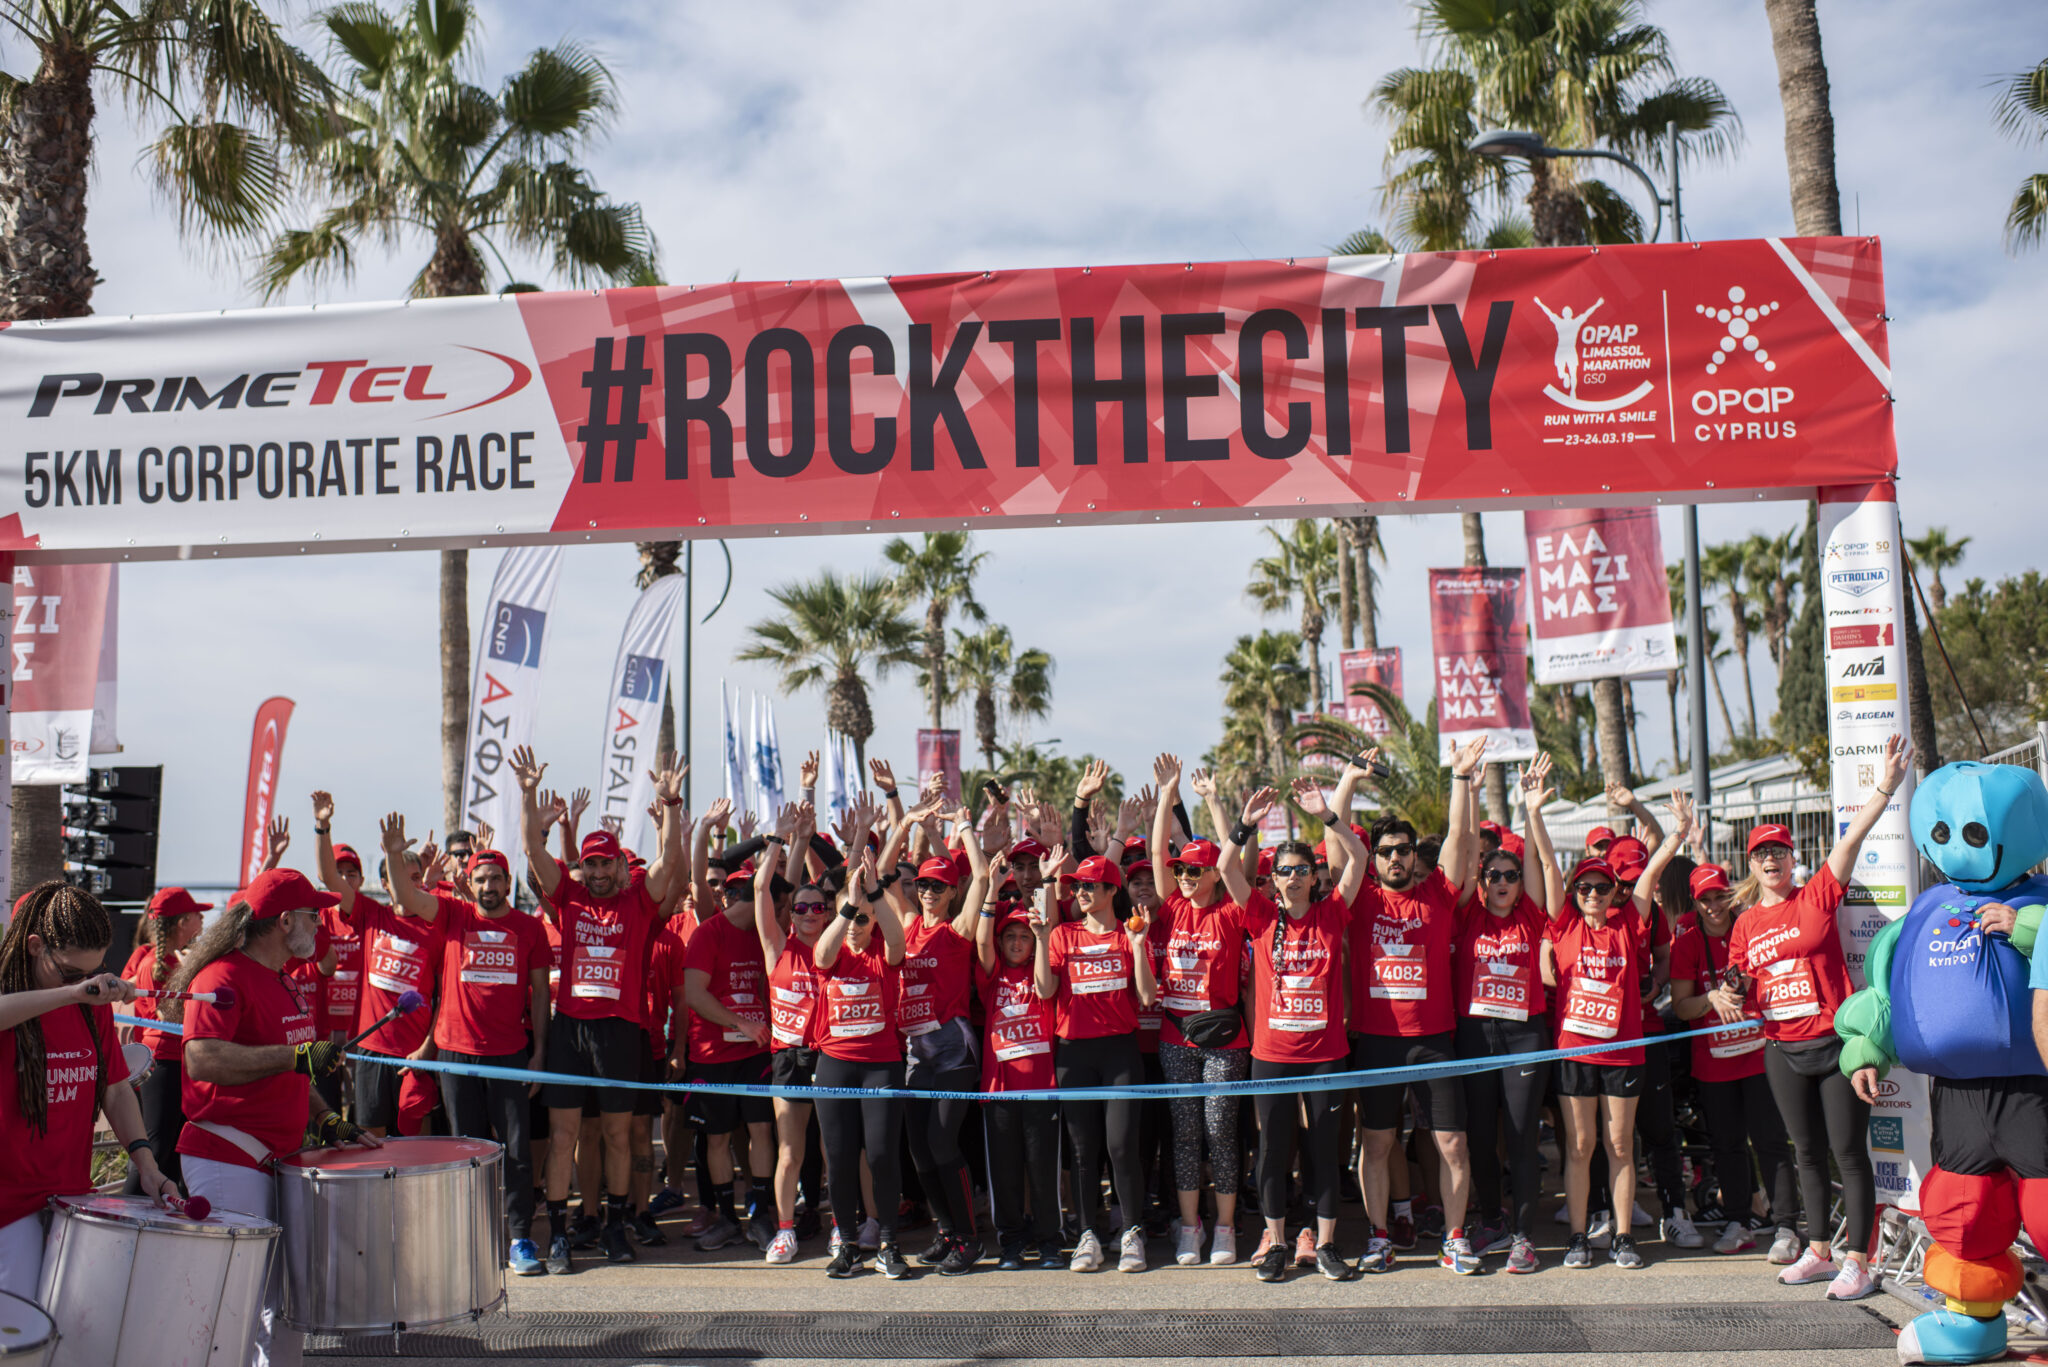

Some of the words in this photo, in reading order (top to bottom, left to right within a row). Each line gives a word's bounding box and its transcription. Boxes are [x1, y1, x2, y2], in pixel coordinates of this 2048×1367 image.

[1581, 324, 1639, 345] OPAP
[1582, 345, 1644, 359] LIMASSOL
[1583, 358, 1651, 372] MARATHON
[1583, 373, 1607, 385] GSO
[577, 300, 1515, 484] #ROCKTHECITY
[1544, 415, 1570, 426] RUN
[1573, 413, 1604, 425] WITH
[1607, 412, 1616, 423] A
[1619, 410, 1657, 423] SMILE
[1565, 432, 1635, 446] 23-24.03.19
[1694, 421, 1797, 442] CYPRUS
[24, 448, 122, 509] 5KM
[137, 436, 400, 503] CORPORATE
[415, 430, 536, 494] RACE
[1876, 541, 1890, 550] 50
[1832, 571, 1885, 583] PETROLINA
[494, 607, 512, 655] CNP
[623, 658, 637, 695] CNP
[1855, 711, 1895, 720] AEGEAN
[1834, 745, 1884, 757] GARMI
[1847, 889, 1901, 902] Europcar
[575, 919, 624, 937] RUNNING
[575, 931, 605, 947] TEAM
[1168, 938, 1222, 951] RUNNING
[375, 954, 421, 980] 13972
[467, 950, 515, 967] 12899
[1073, 958, 1122, 977] 12893
[576, 965, 620, 983] 12901
[1374, 965, 1423, 981] 14082
[1165, 978, 1206, 994] 12894
[1477, 982, 1526, 1003] 13983
[1765, 979, 1811, 1003] 12868
[833, 1002, 881, 1020] 12872
[900, 1001, 931, 1020] 12883
[1569, 997, 1617, 1021] 12876
[997, 1021, 1042, 1043] 14121
[46, 1065, 98, 1085] UNNIN
[47, 1085, 78, 1103] EAM
[1876, 1160, 1899, 1177] ICE
[1875, 1175, 1913, 1192] OWER
